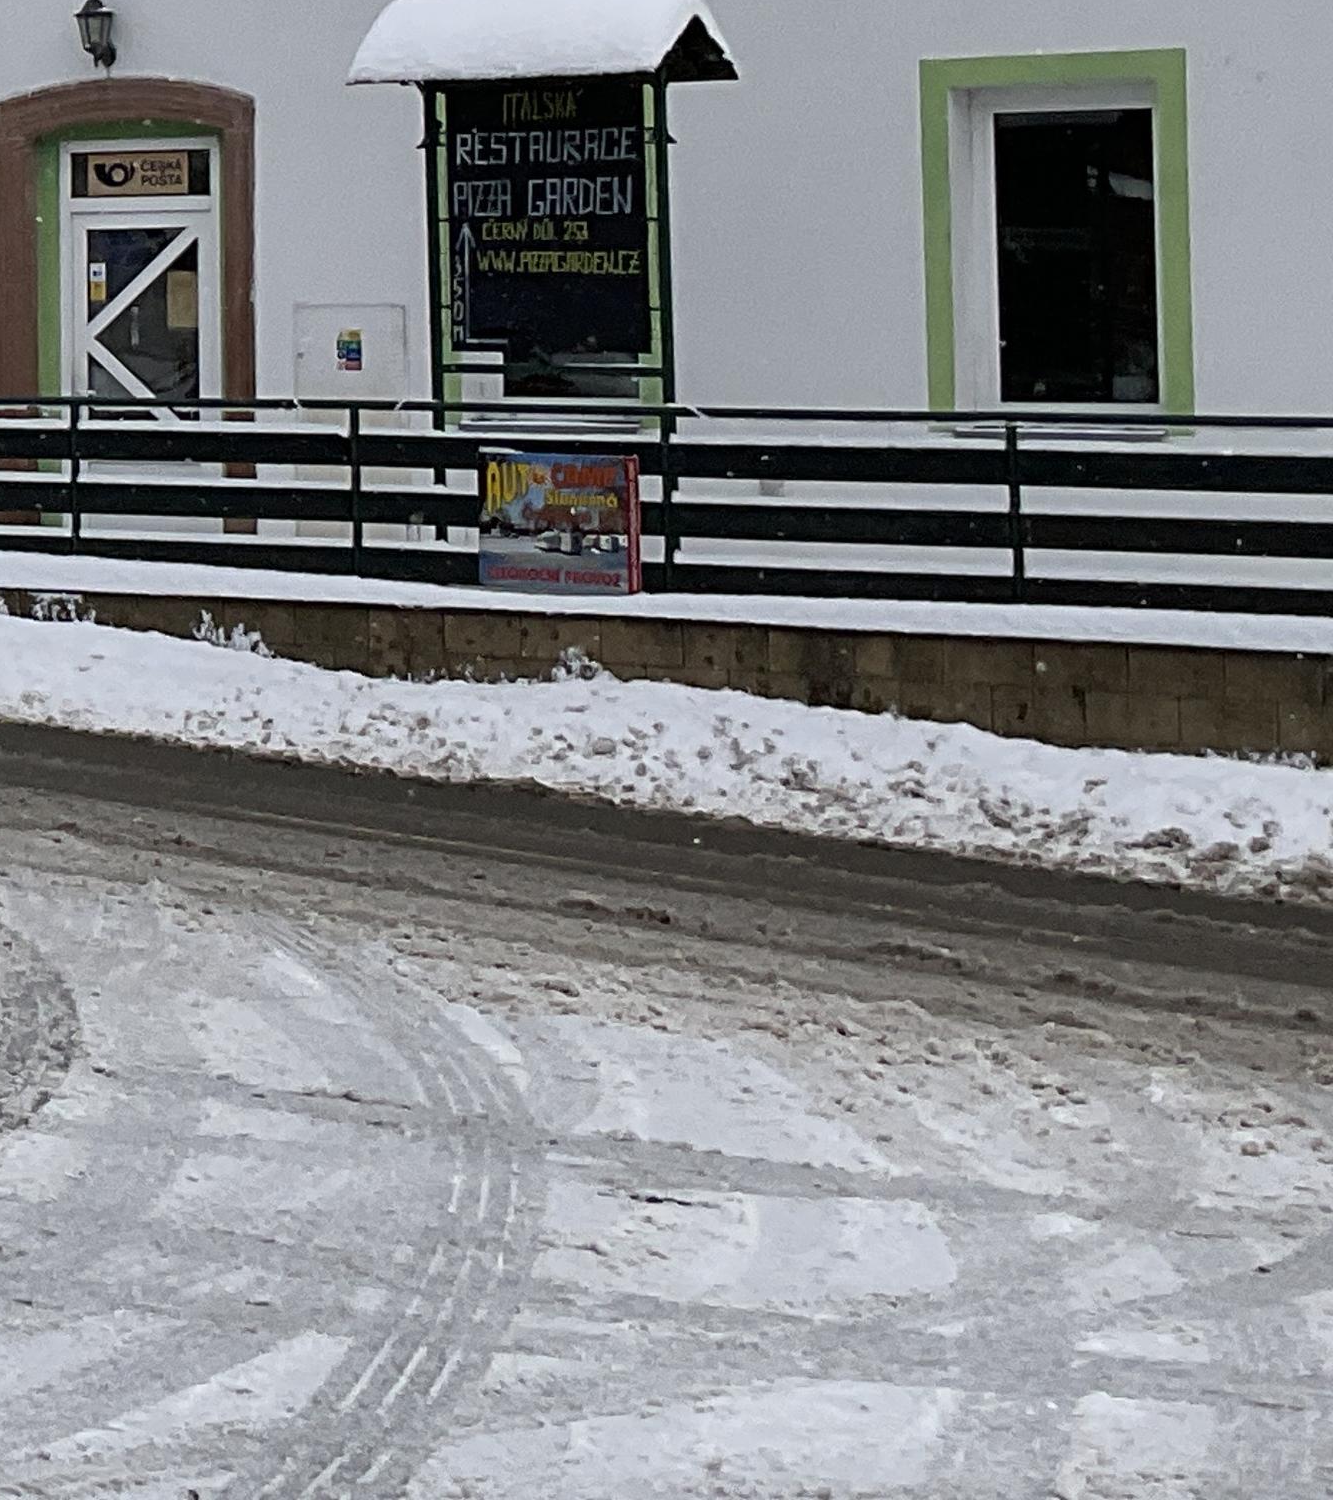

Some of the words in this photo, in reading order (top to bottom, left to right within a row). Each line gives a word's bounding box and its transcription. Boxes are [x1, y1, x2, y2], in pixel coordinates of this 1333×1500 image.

[456, 126, 641, 167] RESTAURACE
[141, 172, 183, 187] POŠTA
[453, 179, 512, 218] PIZZA
[527, 174, 632, 217] GARDEN
